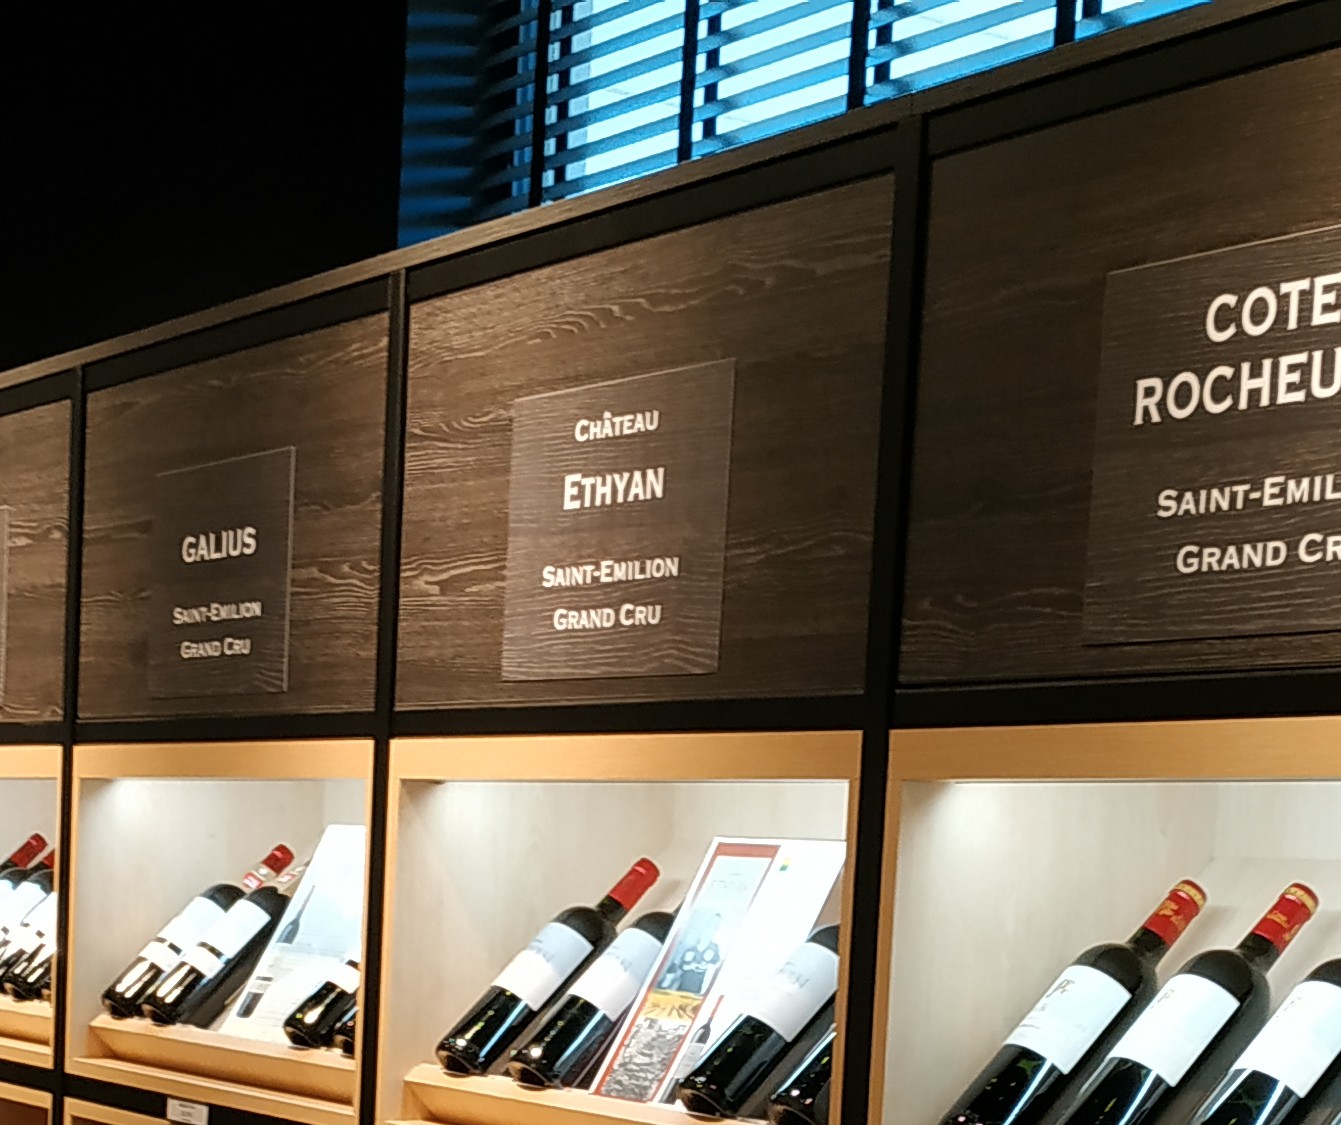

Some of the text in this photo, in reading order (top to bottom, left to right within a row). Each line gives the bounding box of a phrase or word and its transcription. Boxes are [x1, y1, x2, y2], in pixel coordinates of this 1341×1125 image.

[563, 467, 665, 510] ETHYAN
[181, 526, 257, 563] GALIUS
[1175, 541, 1287, 573] GRAND
[541, 556, 679, 588] SAINT-EMILION
[553, 603, 661, 631] GRAND CRU
[180, 637, 251, 659] GRAND CRU
